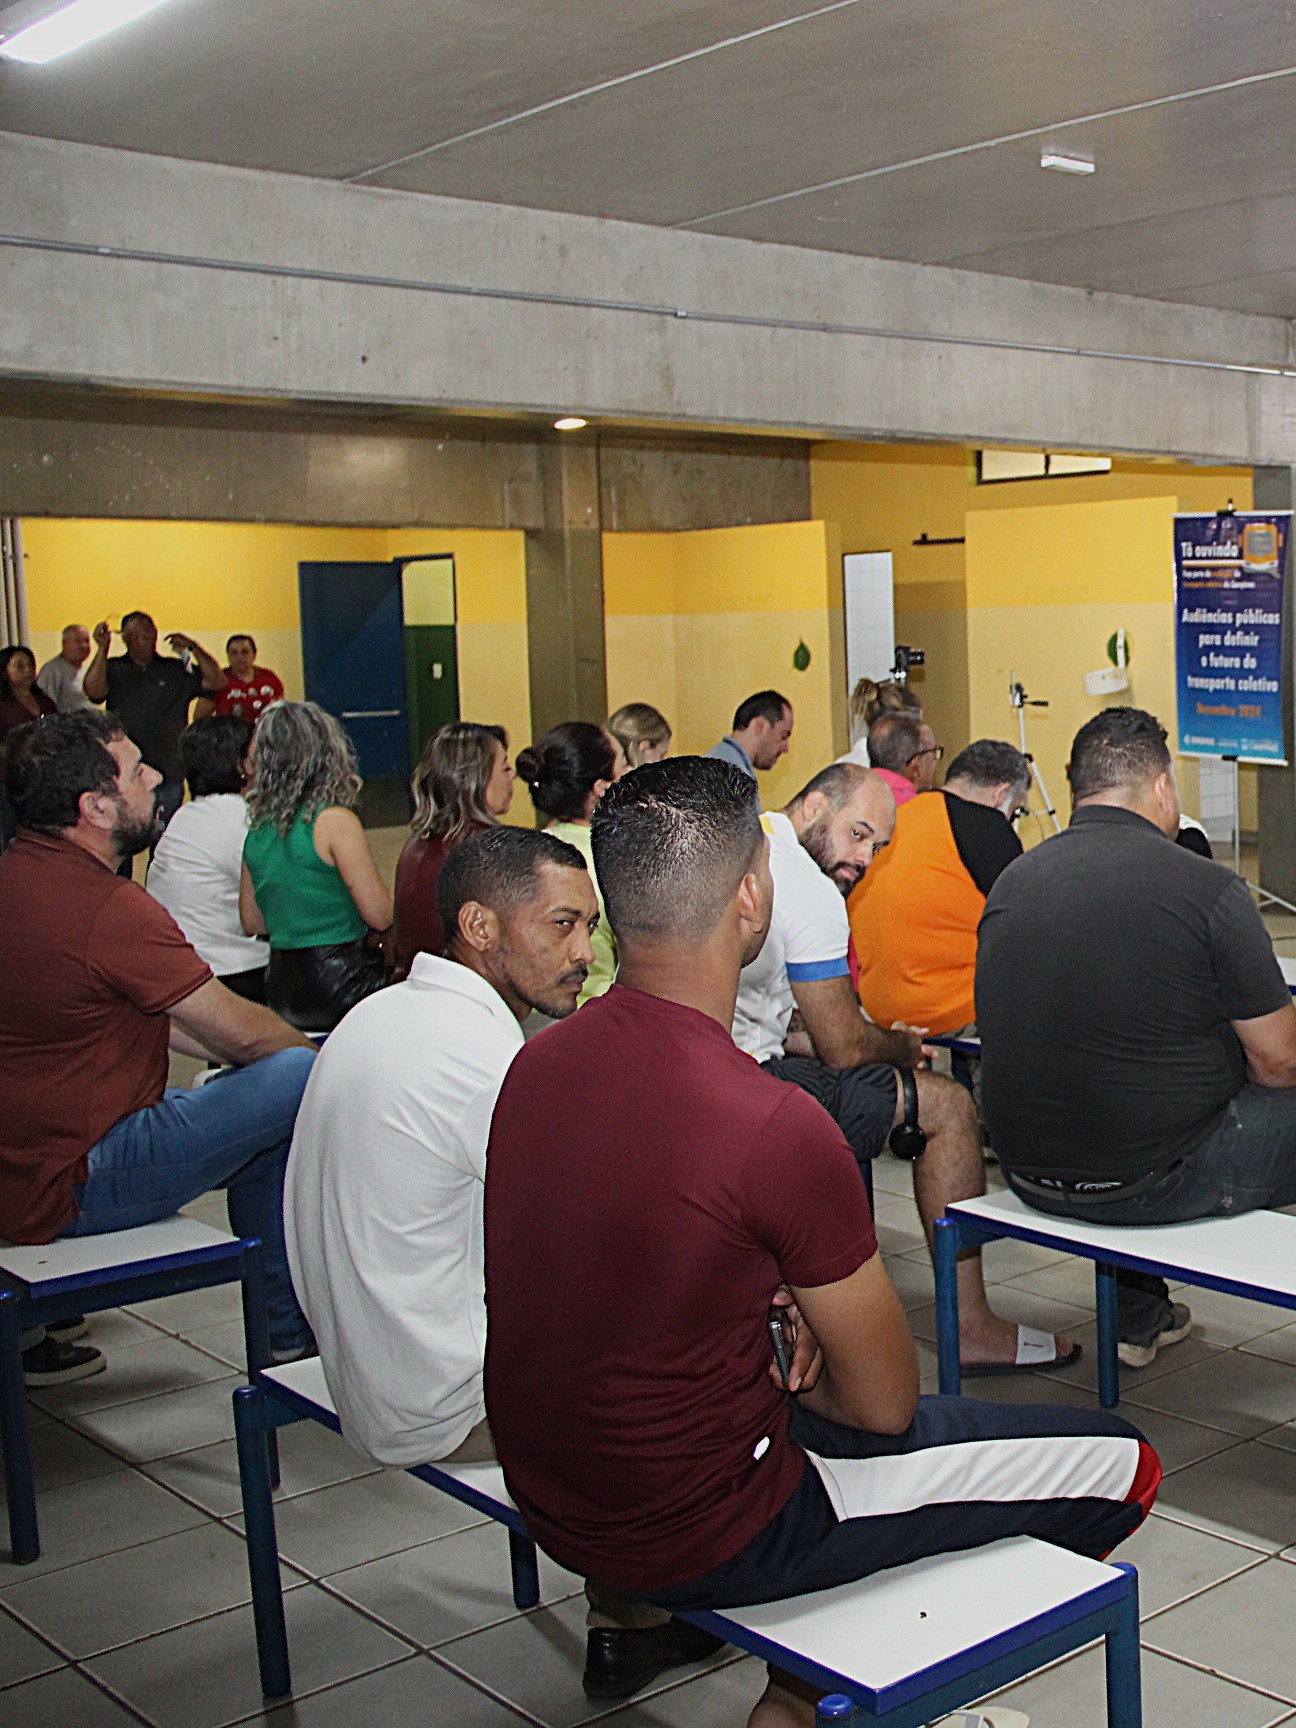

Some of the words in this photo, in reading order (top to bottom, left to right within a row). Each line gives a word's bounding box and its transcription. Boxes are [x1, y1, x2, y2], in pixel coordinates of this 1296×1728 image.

[1181, 541, 1193, 557] Tô
[1195, 540, 1238, 557] ouvindo
[1182, 608, 1233, 623] Audiências
[1235, 608, 1280, 627] públicas
[1198, 633, 1222, 648] para
[1223, 630, 1259, 646] definir
[1201, 655, 1208, 667] o
[1209, 652, 1241, 669] futuro
[1243, 653, 1257, 669] do
[1187, 674, 1236, 692] transporte
[1237, 675, 1278, 692] coletivo
